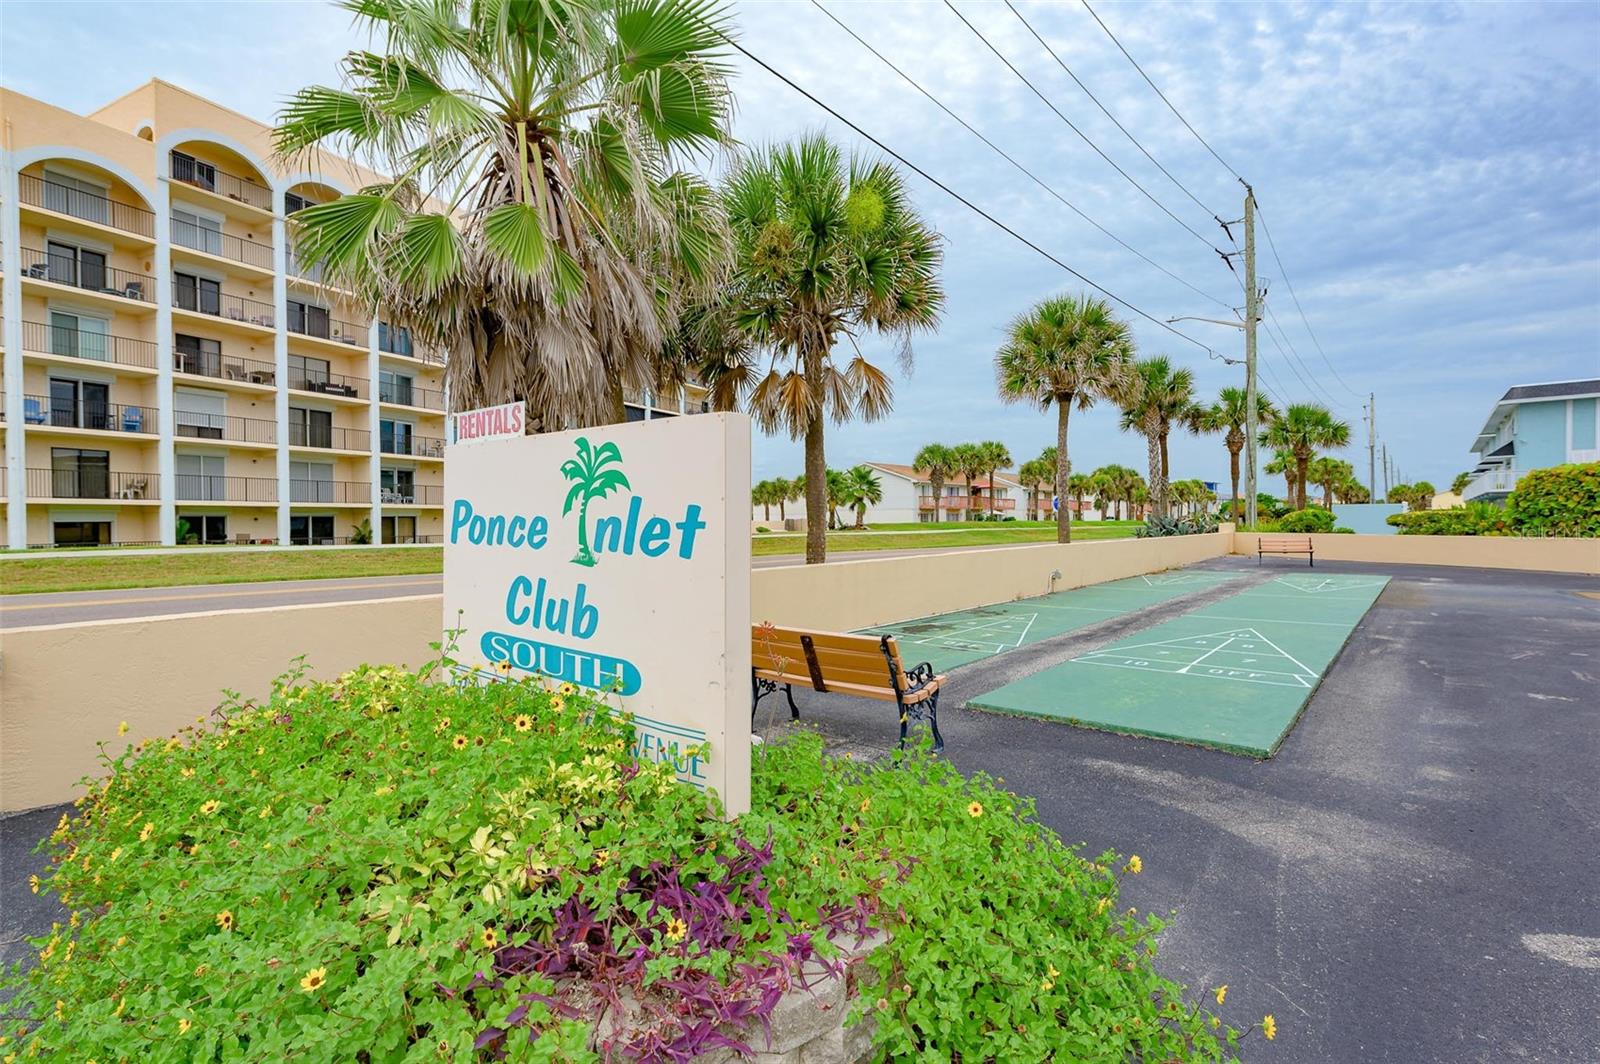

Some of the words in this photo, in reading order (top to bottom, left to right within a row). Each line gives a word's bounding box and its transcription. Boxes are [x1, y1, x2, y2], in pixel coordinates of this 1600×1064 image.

[459, 404, 521, 439] RENTALS
[450, 500, 548, 550] Ponce
[506, 575, 599, 639] Club
[490, 637, 624, 692] SOUTH
[1208, 668, 1266, 678] OFF
[627, 732, 706, 779] VENUE
